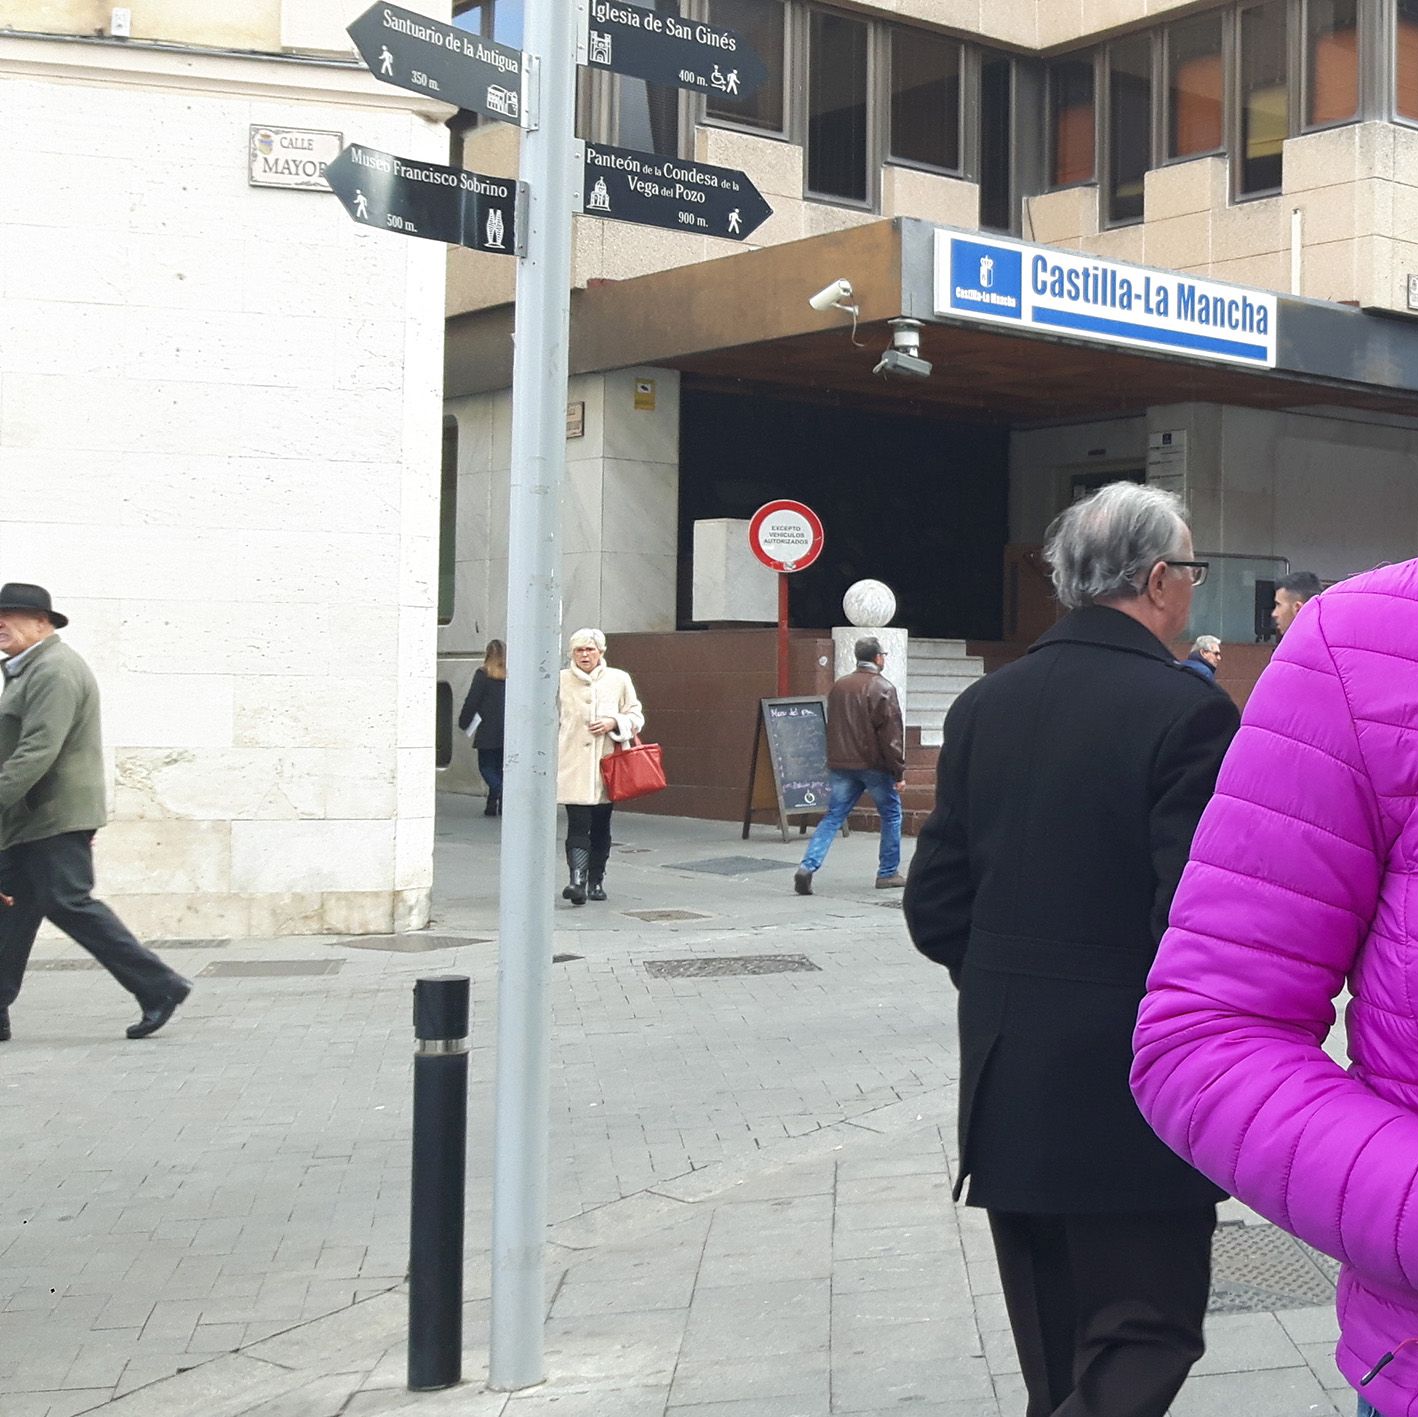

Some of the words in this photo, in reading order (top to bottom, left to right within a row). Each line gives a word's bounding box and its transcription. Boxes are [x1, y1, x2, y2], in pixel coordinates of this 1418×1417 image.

[591, 0, 640, 28] Iglesia
[644, 13, 662, 32] de
[666, 17, 692, 41] San
[695, 25, 736, 51] Ginés
[383, 9, 443, 46] Santuario
[445, 32, 461, 52] de
[463, 38, 474, 57] la
[475, 43, 519, 74] Antigua
[411, 70, 427, 87] 350
[428, 79, 440, 91] m.
[678, 69, 695, 84] 400
[696, 76, 708, 87] m.
[280, 136, 314, 151] CALLE
[351, 147, 391, 173] Museo
[393, 160, 457, 187] Francisco
[460, 172, 508, 198] Sobrino
[586, 148, 641, 173] Panteón
[642, 163, 653, 175] de
[654, 166, 662, 177] la
[663, 162, 718, 187] Condesa
[720, 179, 731, 189] de
[732, 181, 740, 191] la
[628, 174, 659, 198] Vega
[660, 187, 674, 198] del
[675, 183, 706, 204] Pozo
[386, 213, 403, 230] 500
[405, 221, 418, 232] m.
[678, 211, 695, 225] 900
[696, 217, 709, 228] m.
[955, 286, 990, 304] Castilla-La
[991, 293, 1017, 308] Mancha
[1032, 254, 1169, 318] Castilla-La
[1177, 282, 1268, 335] Mancha
